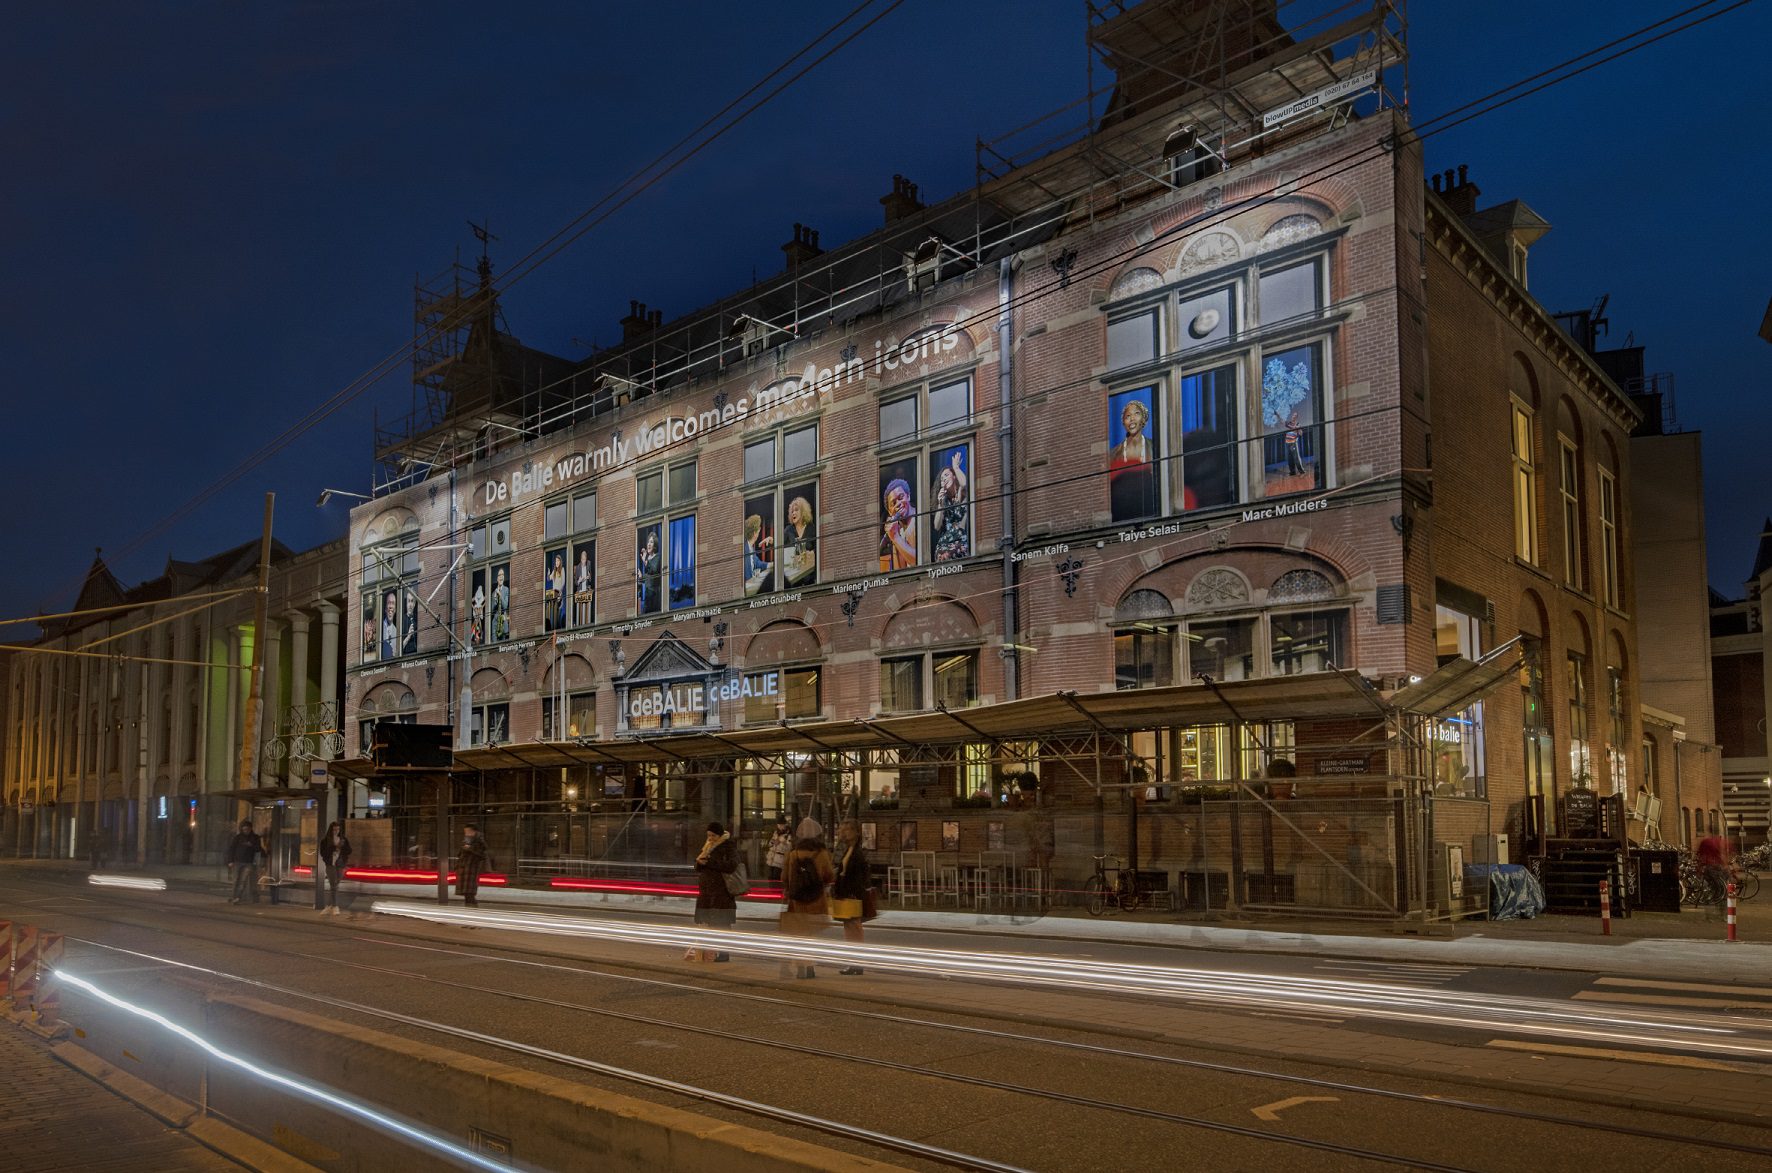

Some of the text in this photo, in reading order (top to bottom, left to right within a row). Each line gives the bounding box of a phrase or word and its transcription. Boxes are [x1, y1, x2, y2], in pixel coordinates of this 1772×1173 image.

[486, 323, 961, 504] De Balie warmly welcomes modern icons
[1242, 499, 1328, 522] Marc Mulders
[1118, 522, 1180, 543] Taiye Selasi
[1010, 543, 1069, 562] Sanem Kalfa
[926, 564, 963, 579] Typhoon
[832, 577, 890, 595] Marlene Dumas
[770, 592, 802, 605] Grunberg
[612, 623, 633, 633] Timothy
[631, 687, 704, 717] deBALIE
[1439, 724, 1460, 743] balie
